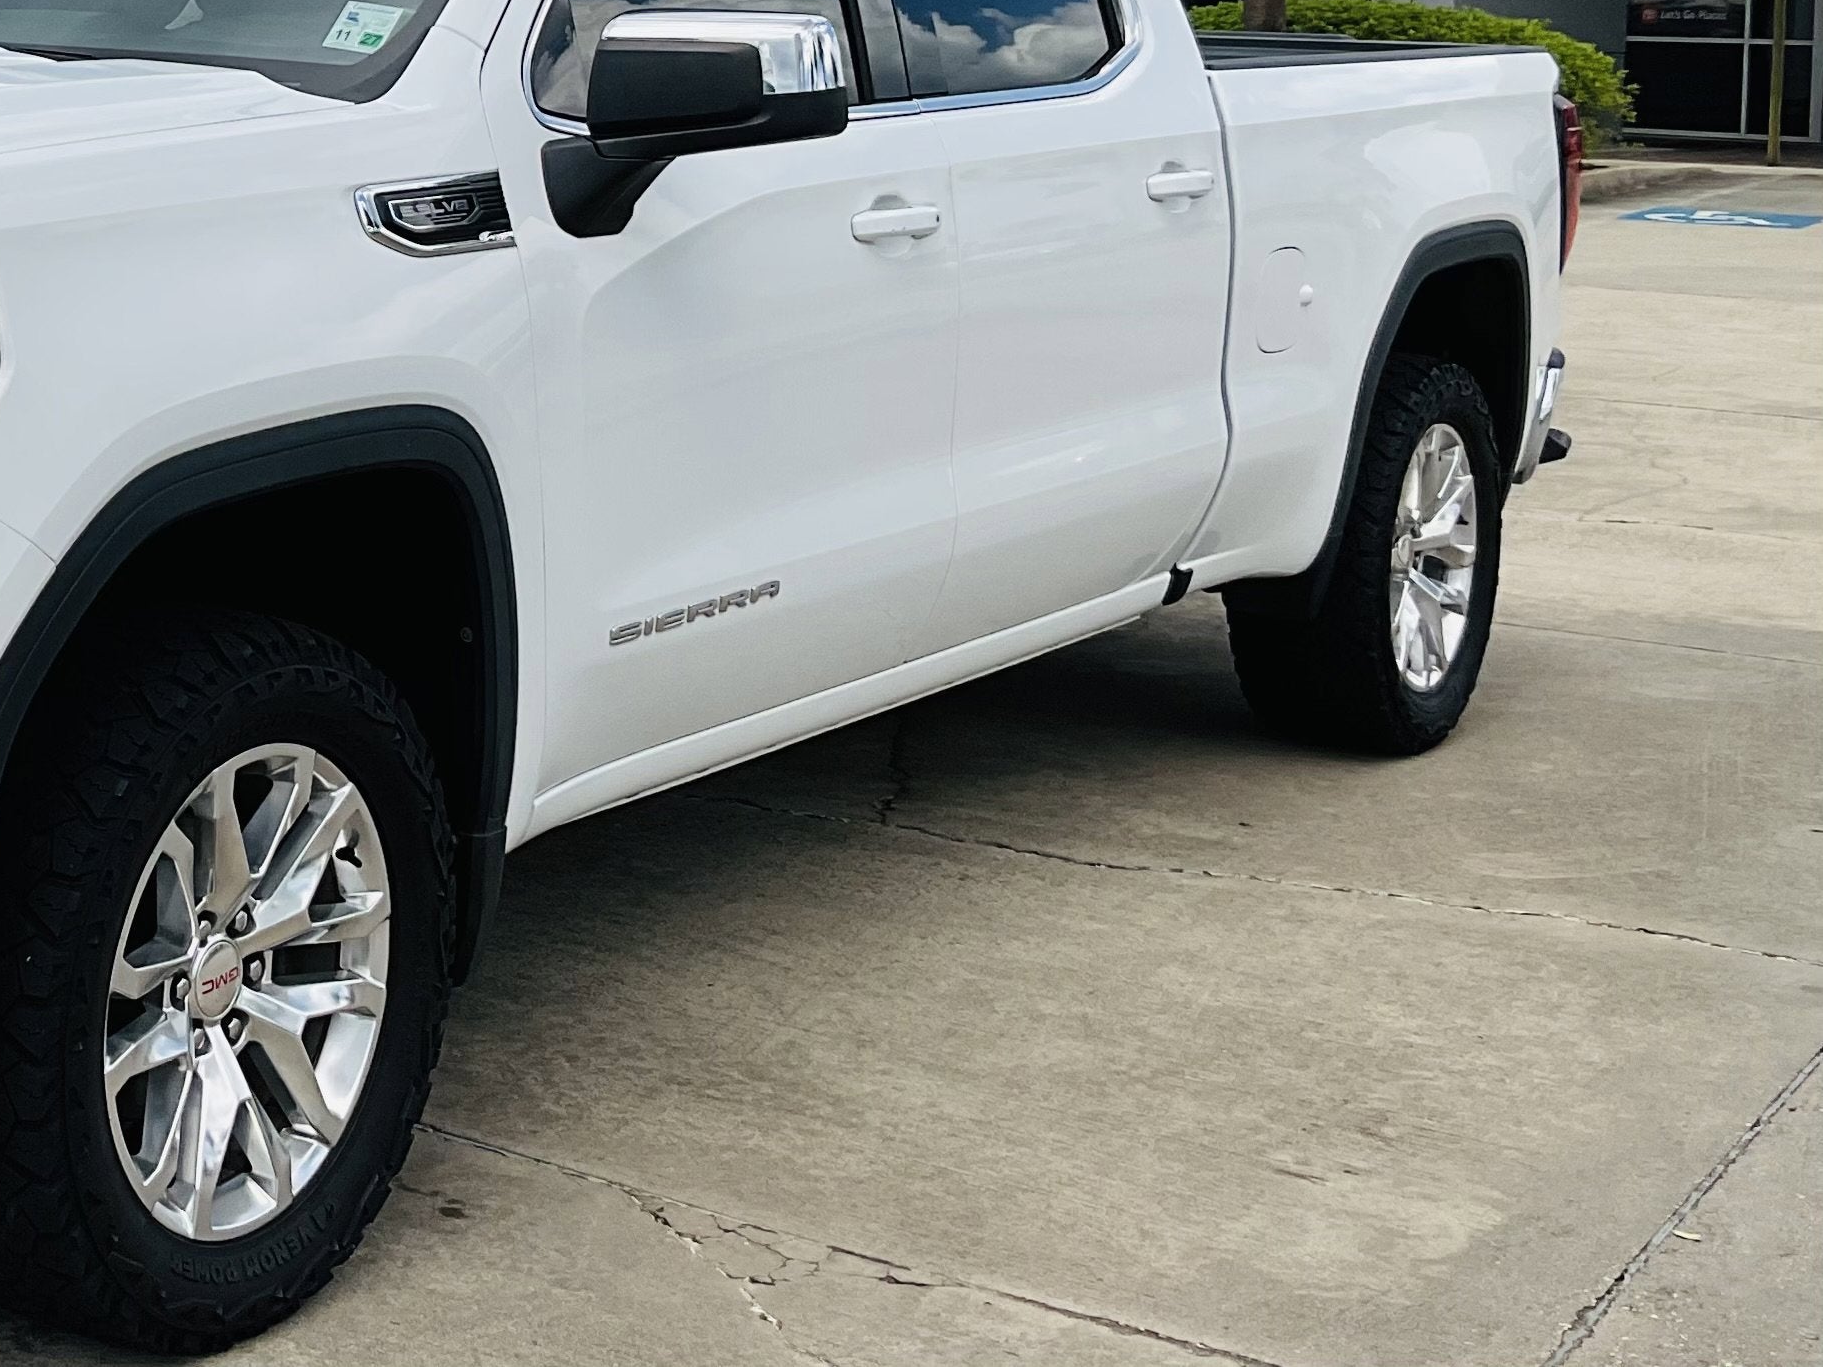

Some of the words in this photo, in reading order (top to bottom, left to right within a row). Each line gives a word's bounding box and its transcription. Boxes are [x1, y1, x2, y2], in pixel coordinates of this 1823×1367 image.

[336, 29, 352, 41] 11
[609, 580, 781, 646] SIERRA
[202, 966, 239, 994] GMC
[241, 1225, 313, 1279] VENOM
